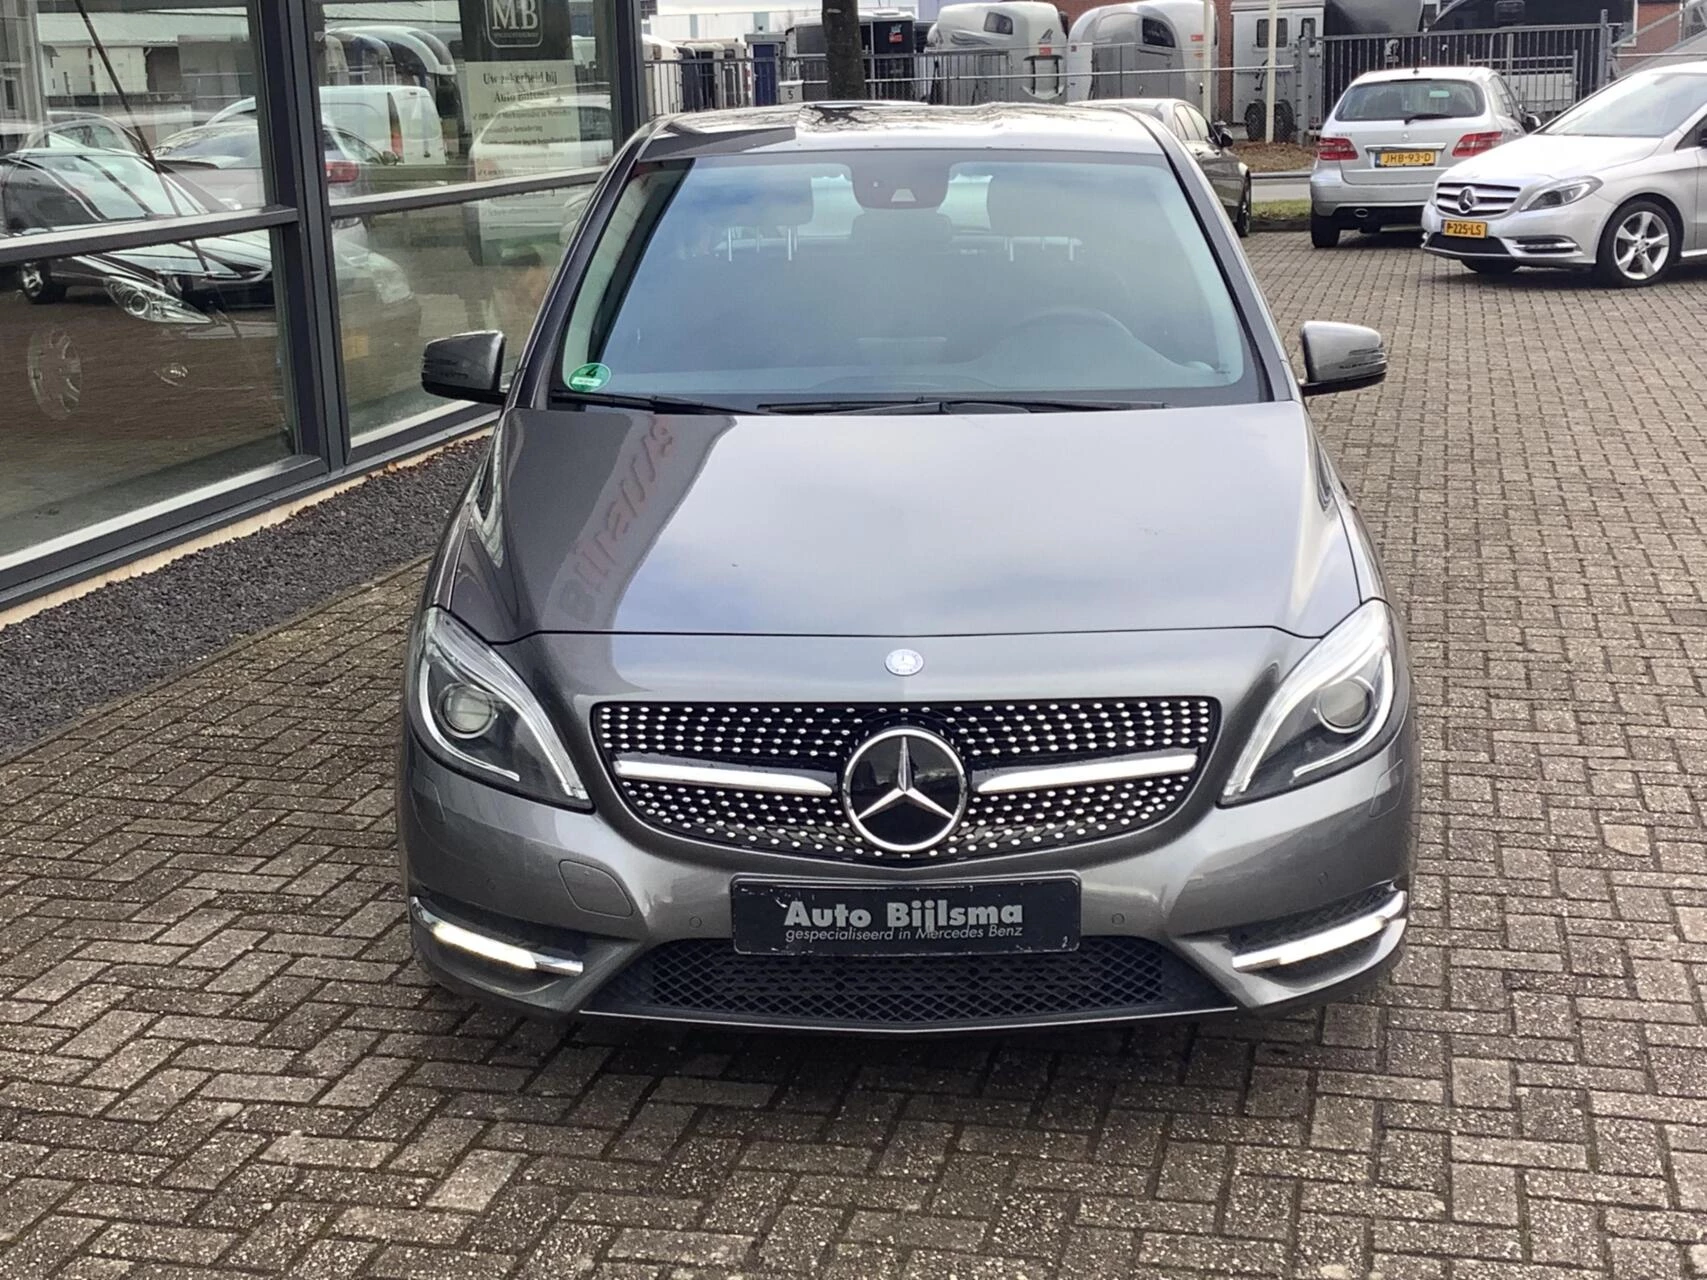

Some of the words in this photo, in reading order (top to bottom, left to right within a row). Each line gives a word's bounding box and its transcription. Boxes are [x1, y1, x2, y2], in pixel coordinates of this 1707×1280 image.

[492, 0, 538, 29] MB
[1383, 152, 1431, 164] JHB-93-D
[784, 901, 872, 927] Auto
[886, 899, 1023, 932] Bijlsma
[785, 927, 894, 943] gespecialiseerd
[898, 926, 911, 940] in
[917, 925, 984, 940] Mercedes
[988, 924, 1023, 938] Benz
